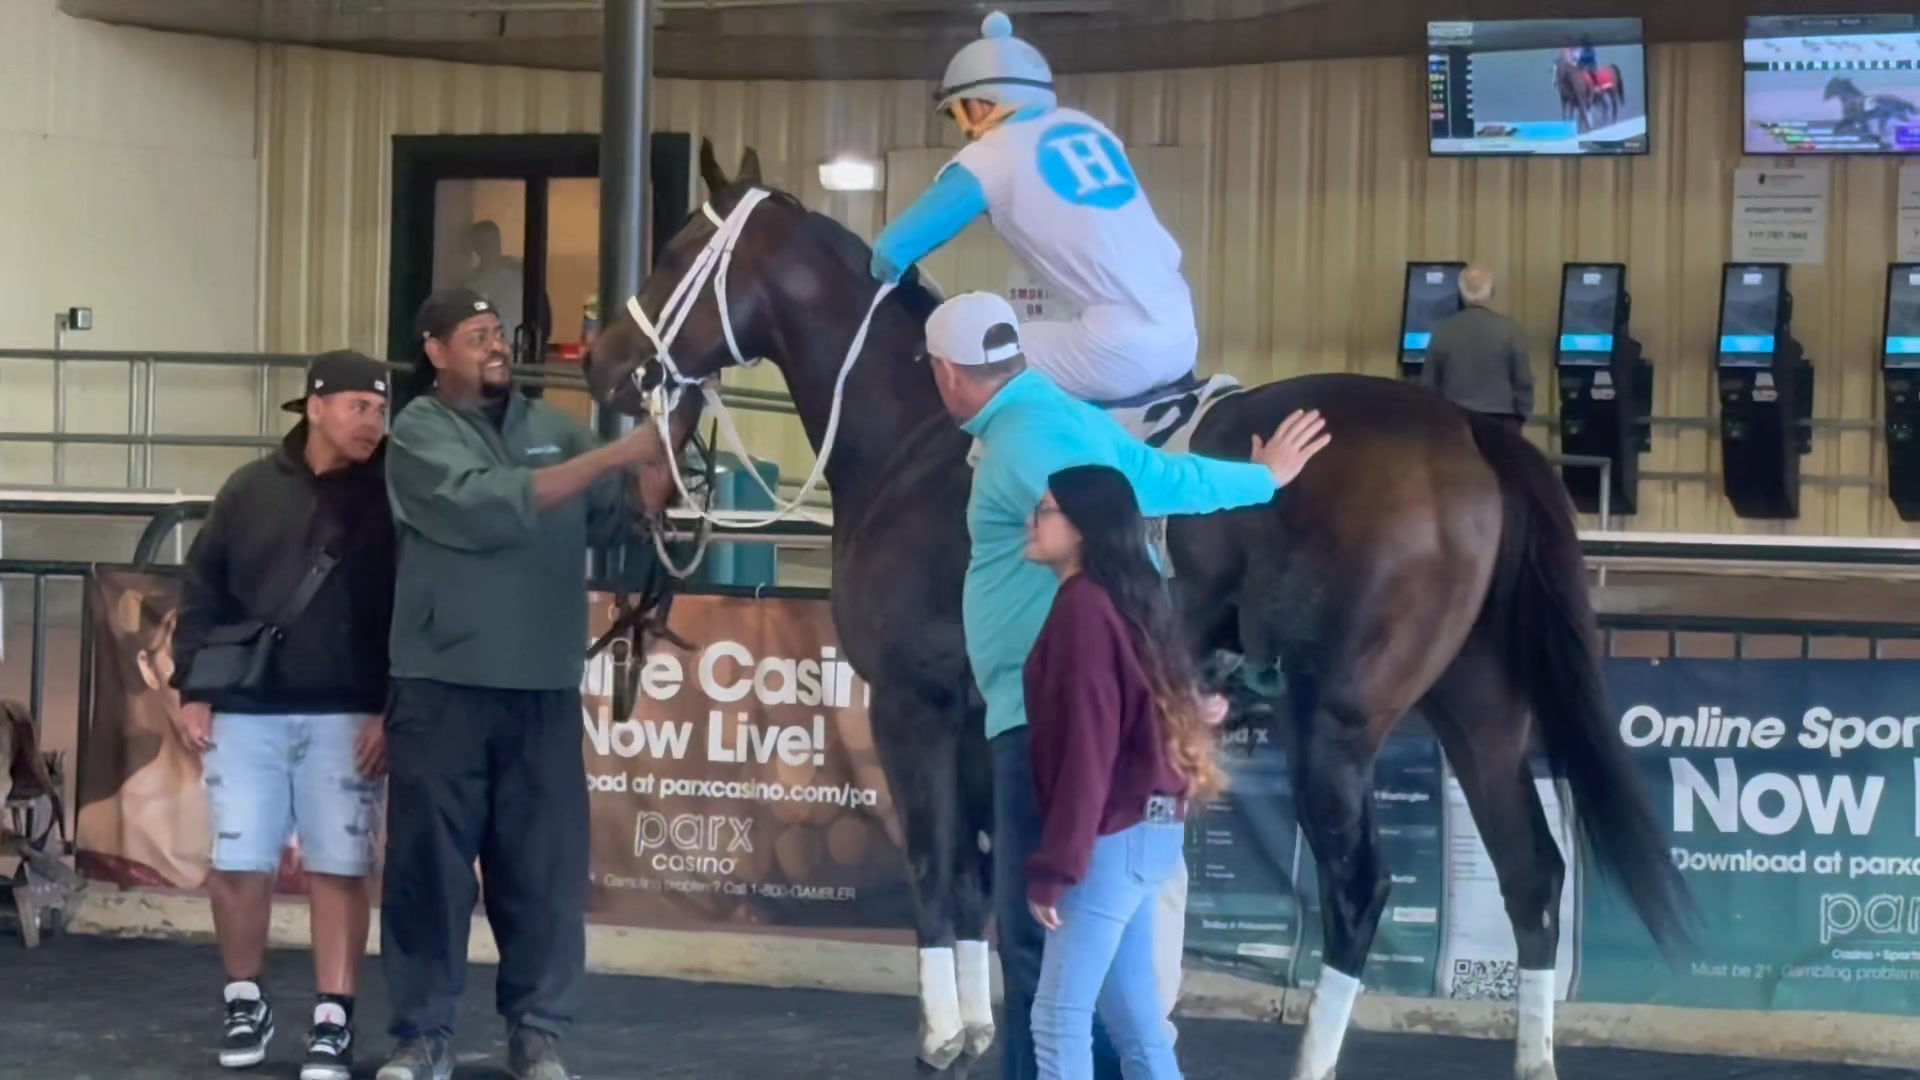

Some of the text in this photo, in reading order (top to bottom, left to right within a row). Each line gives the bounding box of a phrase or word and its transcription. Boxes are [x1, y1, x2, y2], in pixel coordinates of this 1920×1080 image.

[1048, 133, 1132, 195] H
[583, 705, 825, 766] Now Live!
[1619, 705, 1785, 749] Online
[632, 774, 654, 793] at
[660, 777, 877, 808] parxcasino.com/pa
[1668, 757, 1885, 836] Now
[634, 811, 754, 856] parx
[652, 853, 736, 875] casino
[1671, 848, 1806, 873] Download
[1813, 853, 1841, 874] at
